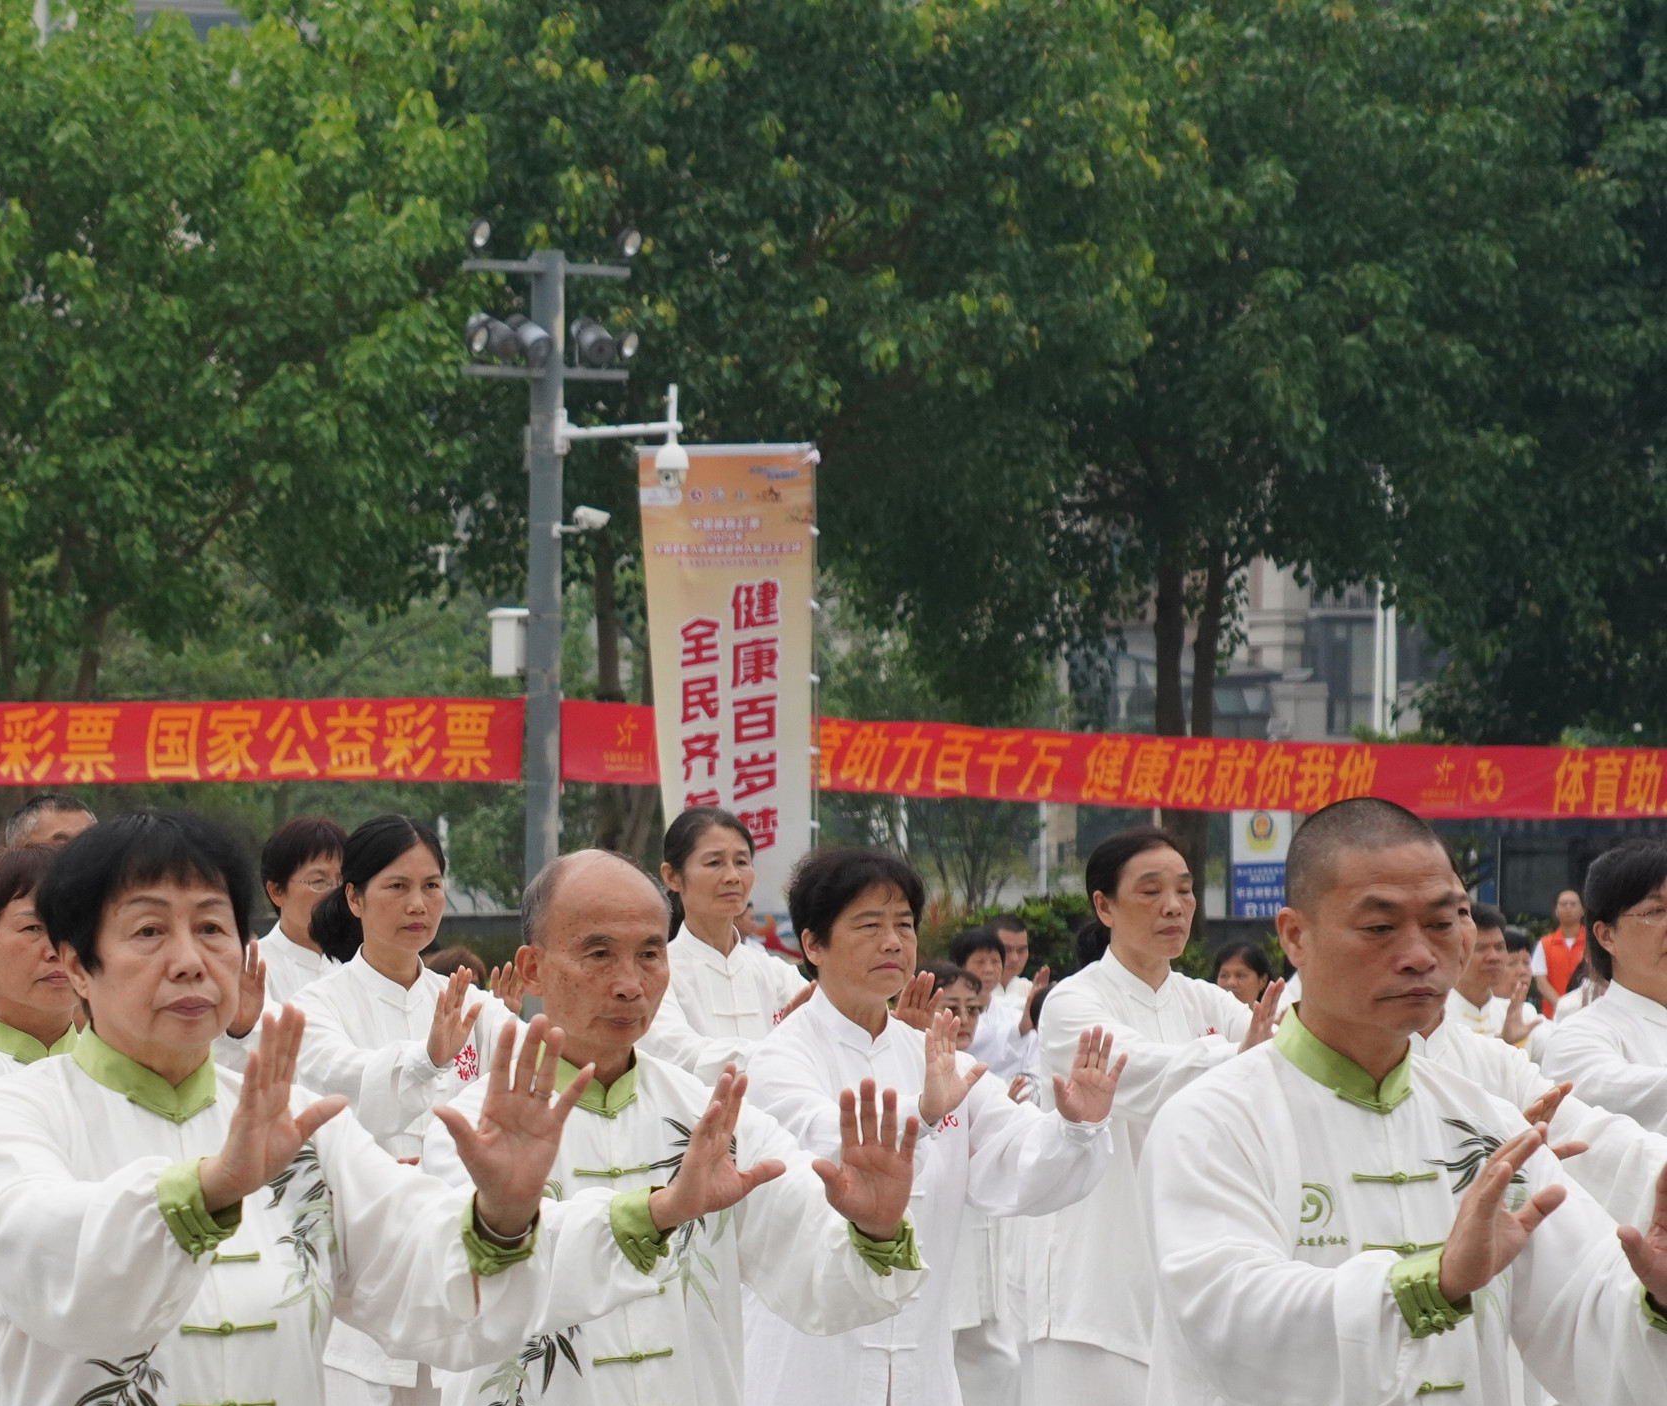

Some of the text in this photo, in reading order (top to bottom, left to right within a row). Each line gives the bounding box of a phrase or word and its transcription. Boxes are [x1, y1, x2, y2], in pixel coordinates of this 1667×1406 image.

[146, 698, 496, 779] 国家公益彩票
[731, 580, 779, 850] 健康百岁梦
[1081, 736, 1379, 809] 健康成就你我他
[1470, 759, 1504, 802] 30
[1552, 751, 1667, 815] 体育助
